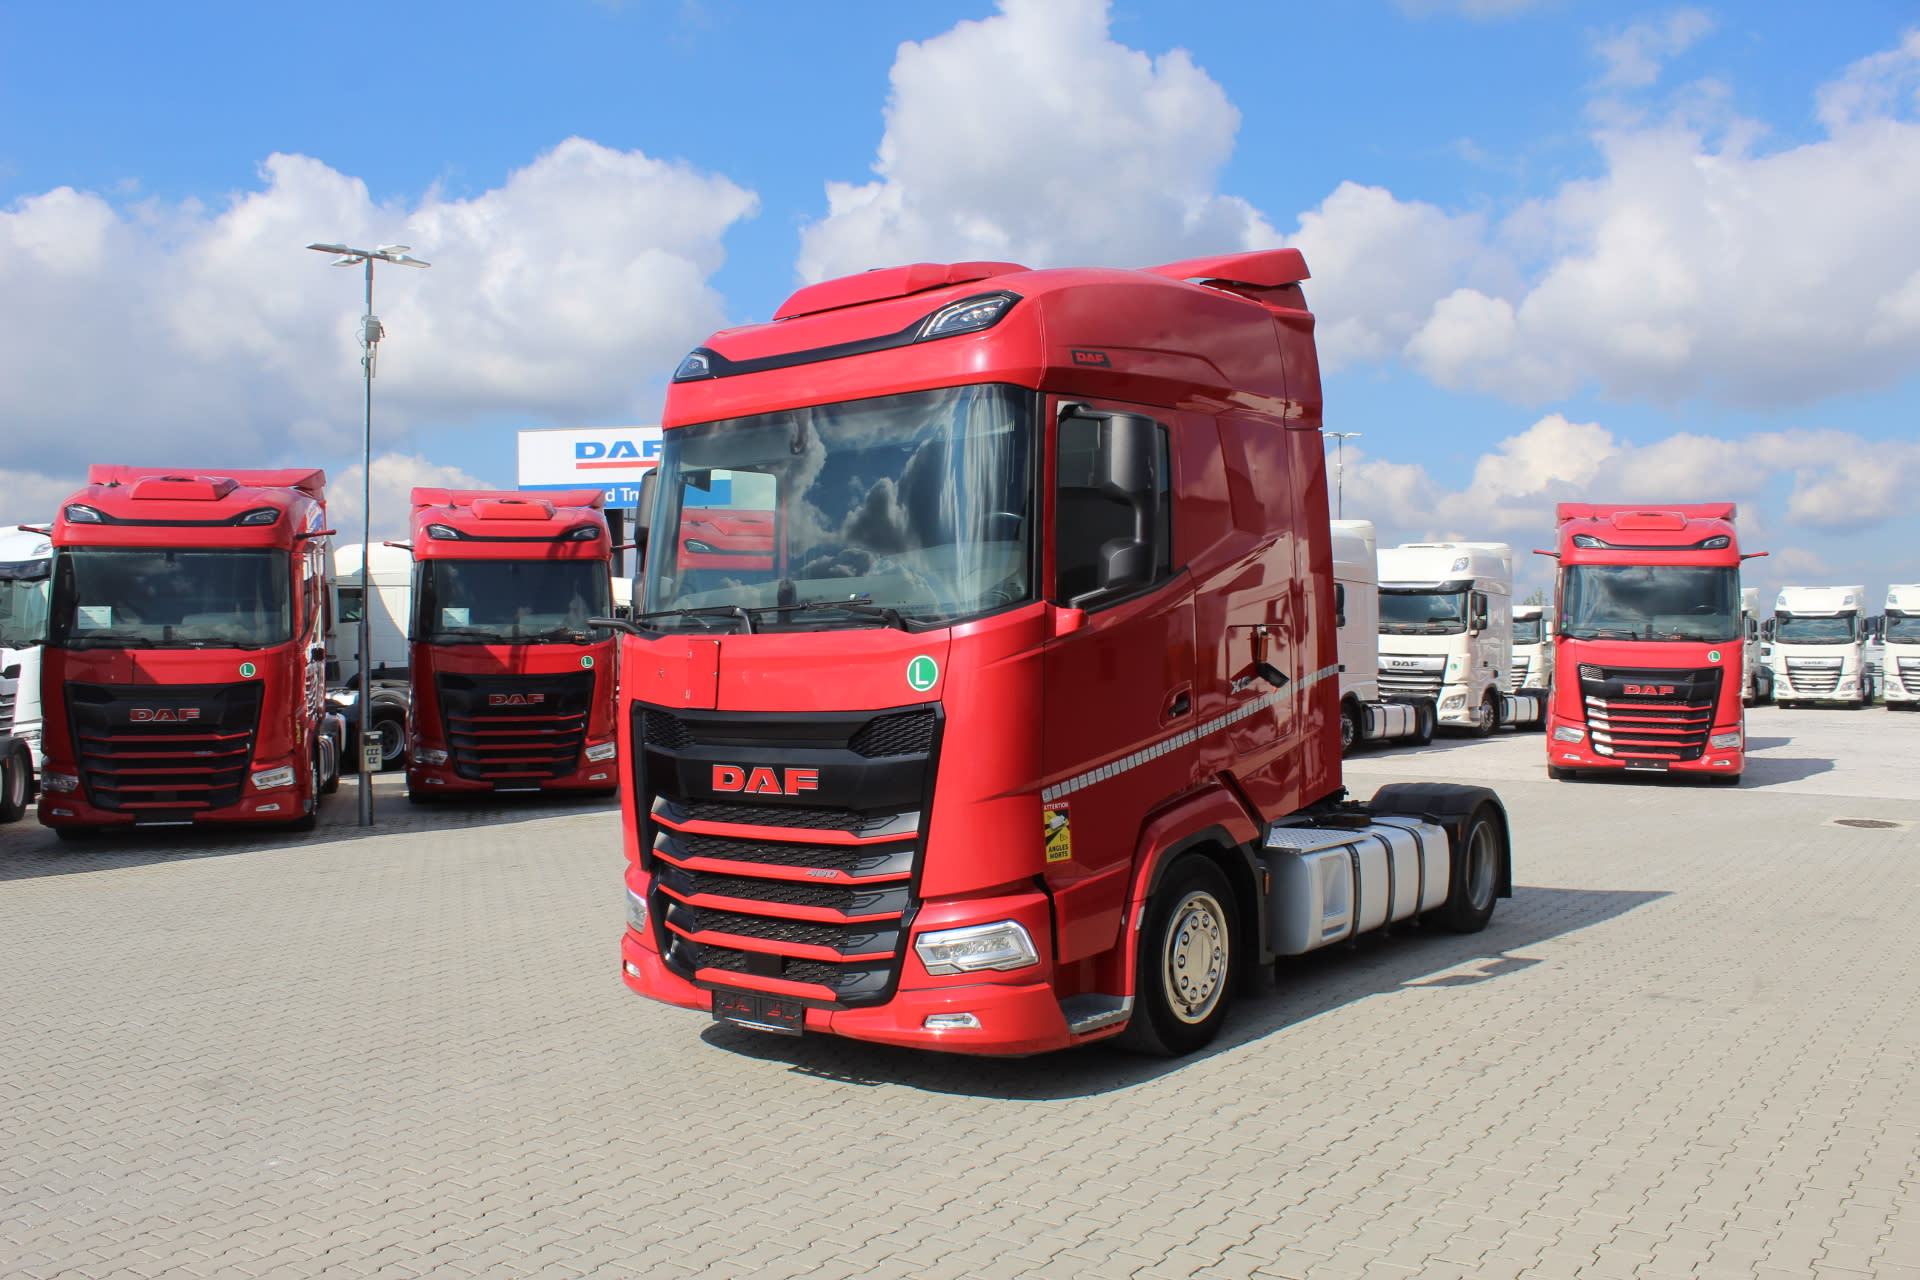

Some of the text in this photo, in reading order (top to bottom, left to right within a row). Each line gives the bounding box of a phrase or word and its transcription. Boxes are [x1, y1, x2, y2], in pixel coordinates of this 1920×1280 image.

[1075, 351, 1105, 363] DAF
[575, 440, 663, 459] DAF
[1623, 684, 1675, 696] DAF
[489, 694, 544, 706] DAF
[130, 708, 200, 722] DAF
[712, 764, 819, 796] DAF
[1048, 843, 1069, 853] ANGLES
